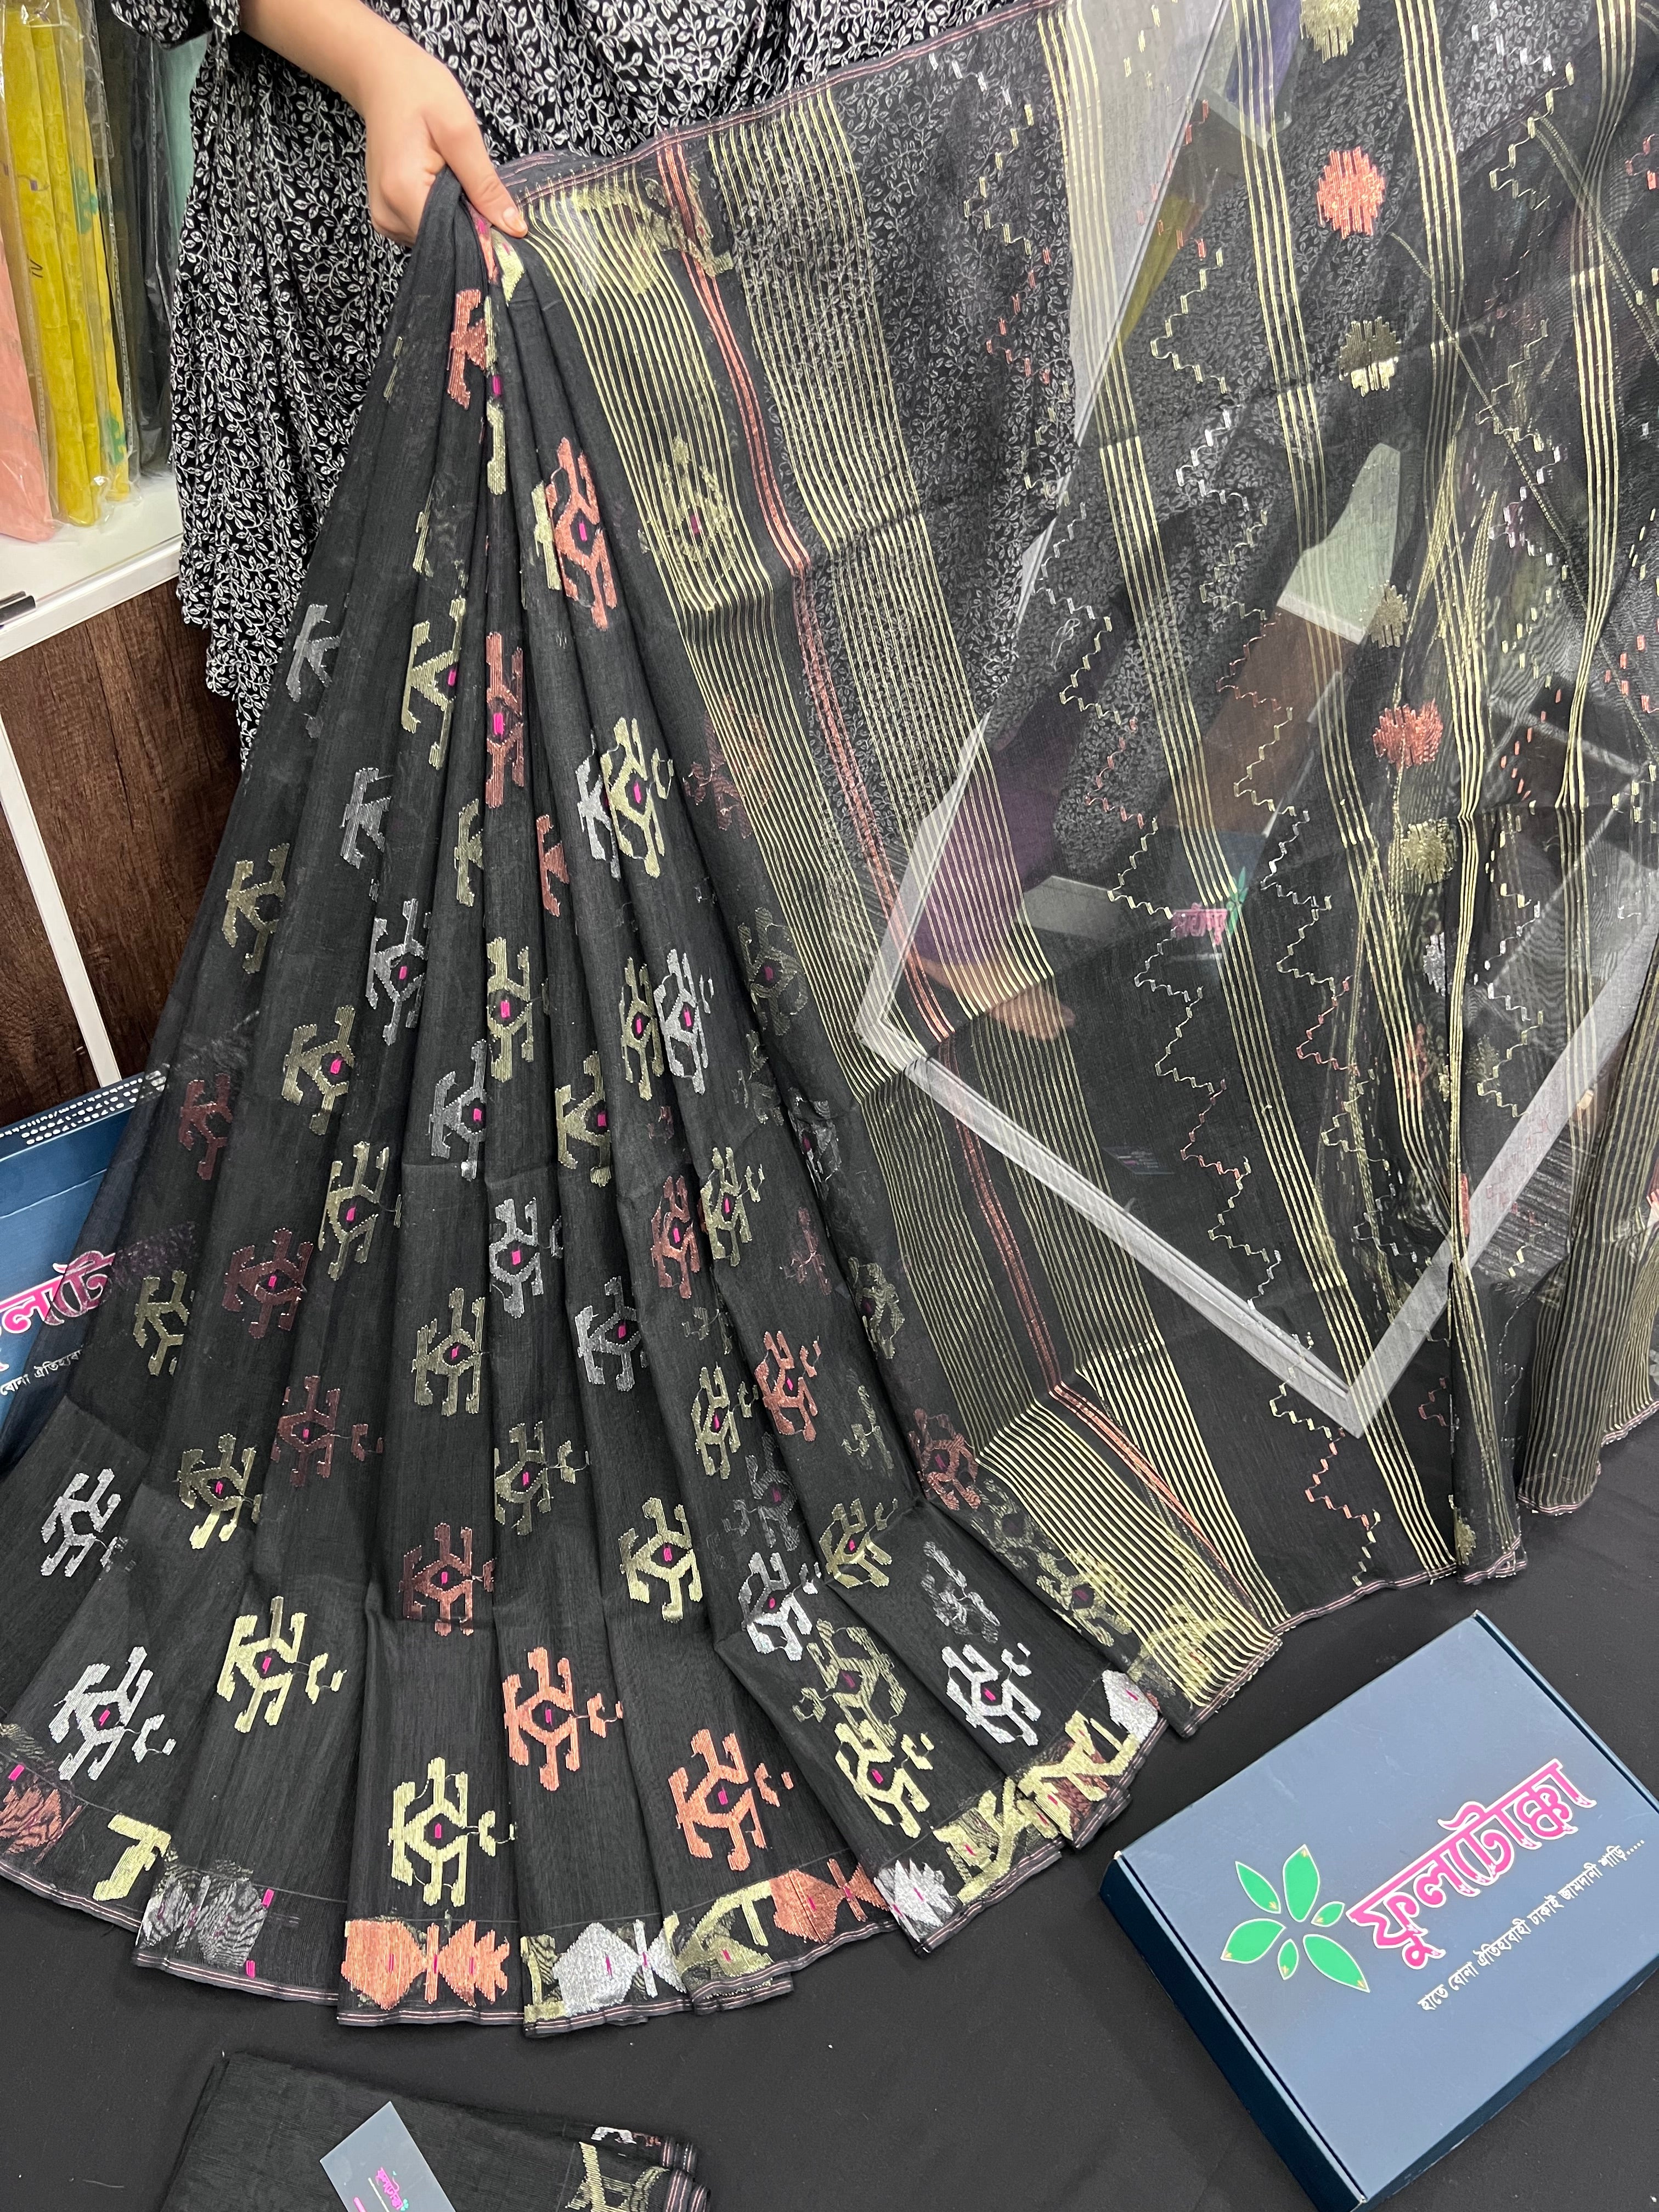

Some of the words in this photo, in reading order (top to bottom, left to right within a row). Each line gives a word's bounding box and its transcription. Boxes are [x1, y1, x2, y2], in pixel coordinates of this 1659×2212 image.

[1417, 1984, 1448, 2011] হাতে
[1448, 1961, 1479, 1991] বোনা
[1472, 1918, 1532, 1967] ঐতিহ্যবাহী
[1526, 1894, 1565, 1925] ঢাকাই
[1557, 1862, 1603, 1900] জামদানী
